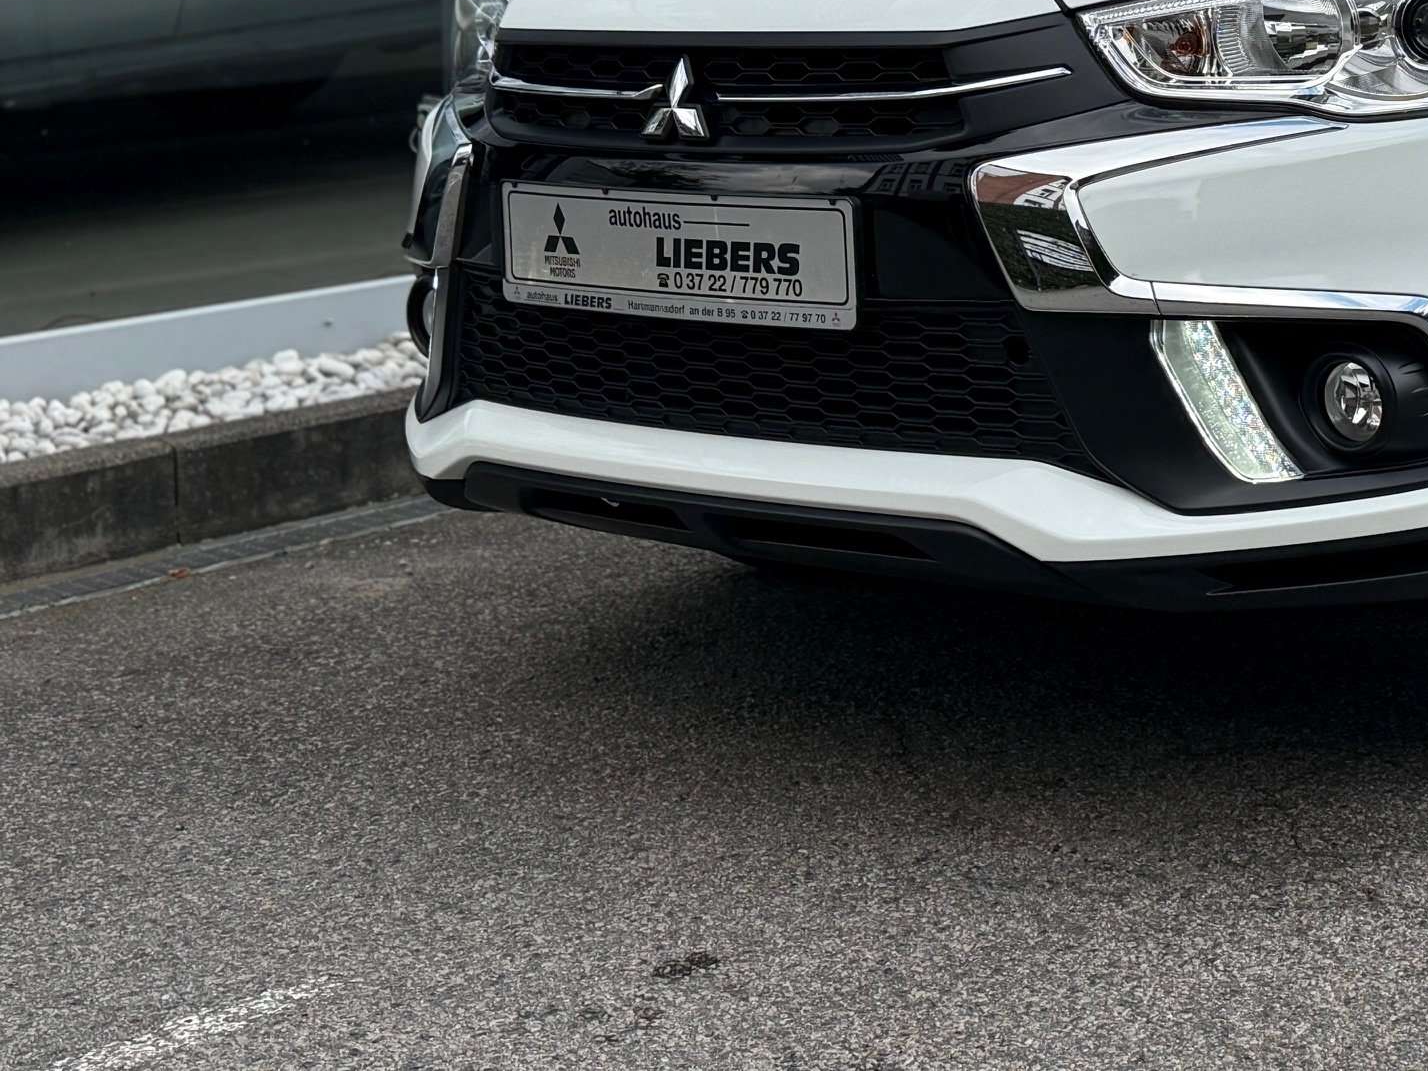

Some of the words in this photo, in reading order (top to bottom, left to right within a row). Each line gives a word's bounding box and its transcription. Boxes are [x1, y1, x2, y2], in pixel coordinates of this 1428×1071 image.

[608, 206, 682, 230] autohaus
[544, 255, 581, 268] MITSUBISHI
[655, 236, 800, 276] LIEBERS
[549, 267, 576, 278] MOTORS
[674, 271, 683, 289] 0
[686, 272, 704, 291] 37
[708, 274, 727, 292] 22
[740, 276, 770, 295] 779
[774, 278, 803, 297] 770
[526, 290, 558, 302] autohaus
[564, 292, 613, 310] LIEBERS
[689, 307, 699, 316] an
[701, 306, 714, 317] der
[725, 308, 736, 318] 95
[758, 310, 769, 320] 37
[771, 311, 782, 321] 22
[789, 312, 800, 322] 77
[802, 312, 812, 323] 97
[815, 313, 826, 323] 70
